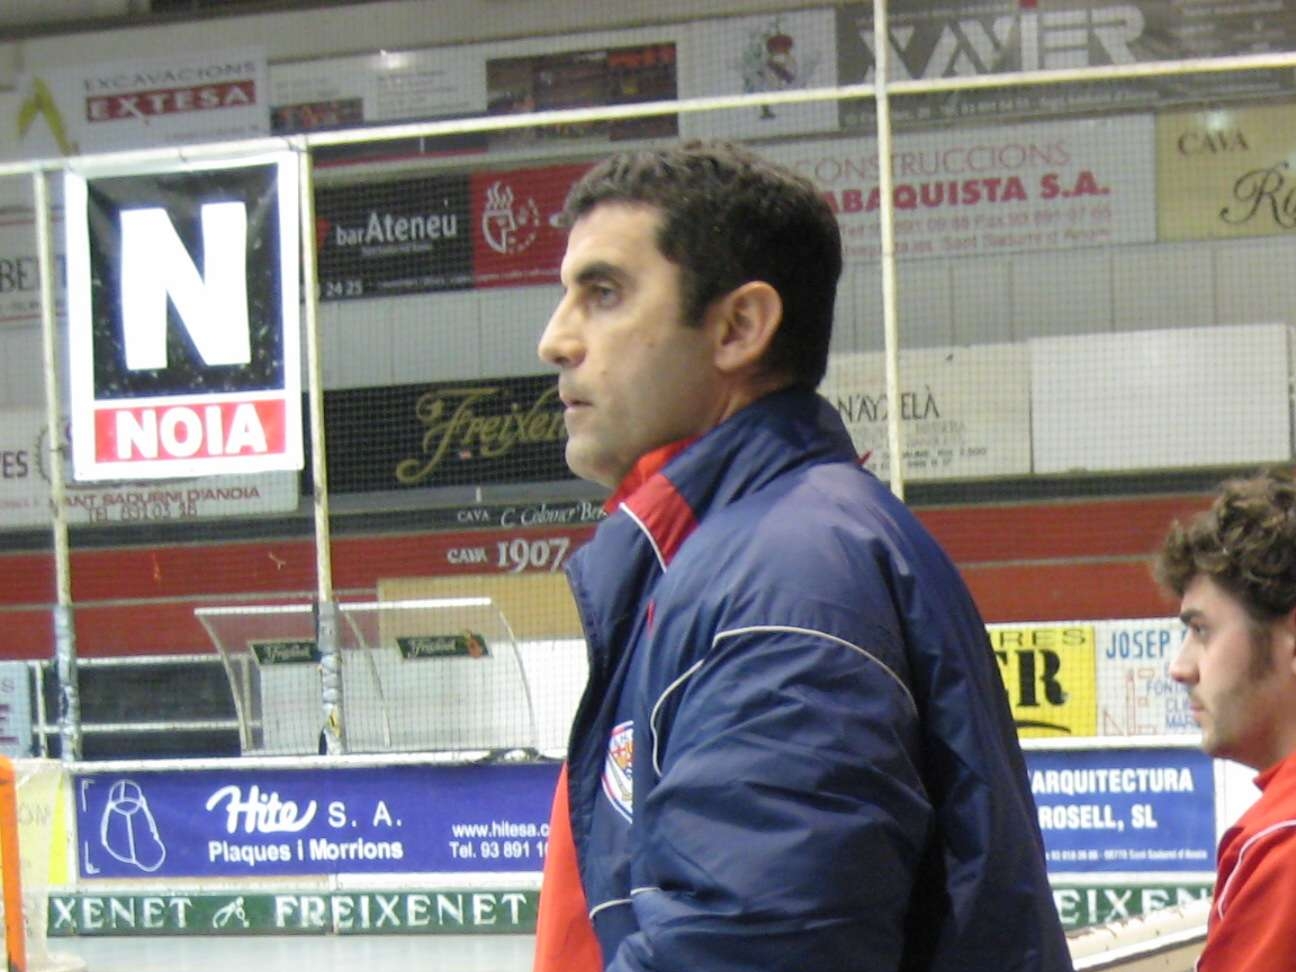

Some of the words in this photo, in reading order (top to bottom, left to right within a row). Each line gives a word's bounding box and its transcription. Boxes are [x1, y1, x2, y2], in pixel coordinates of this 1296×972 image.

[88, 84, 251, 126] EXTESA
[1177, 130, 1249, 157] CAVA
[119, 200, 252, 371] N
[115, 402, 269, 459] NOIA
[497, 536, 571, 574] 1907
[1106, 629, 1171, 659] JOSEP
[205, 785, 318, 834] Hite
[1131, 803, 1158, 828] SL
[208, 841, 292, 867] Plaques
[309, 837, 405, 861] Morrions
[449, 841, 477, 858] Tel.
[480, 841, 500, 858] 93
[503, 841, 530, 858] 891
[54, 896, 192, 929] XENET
[275, 892, 528, 928] FREIXENET
